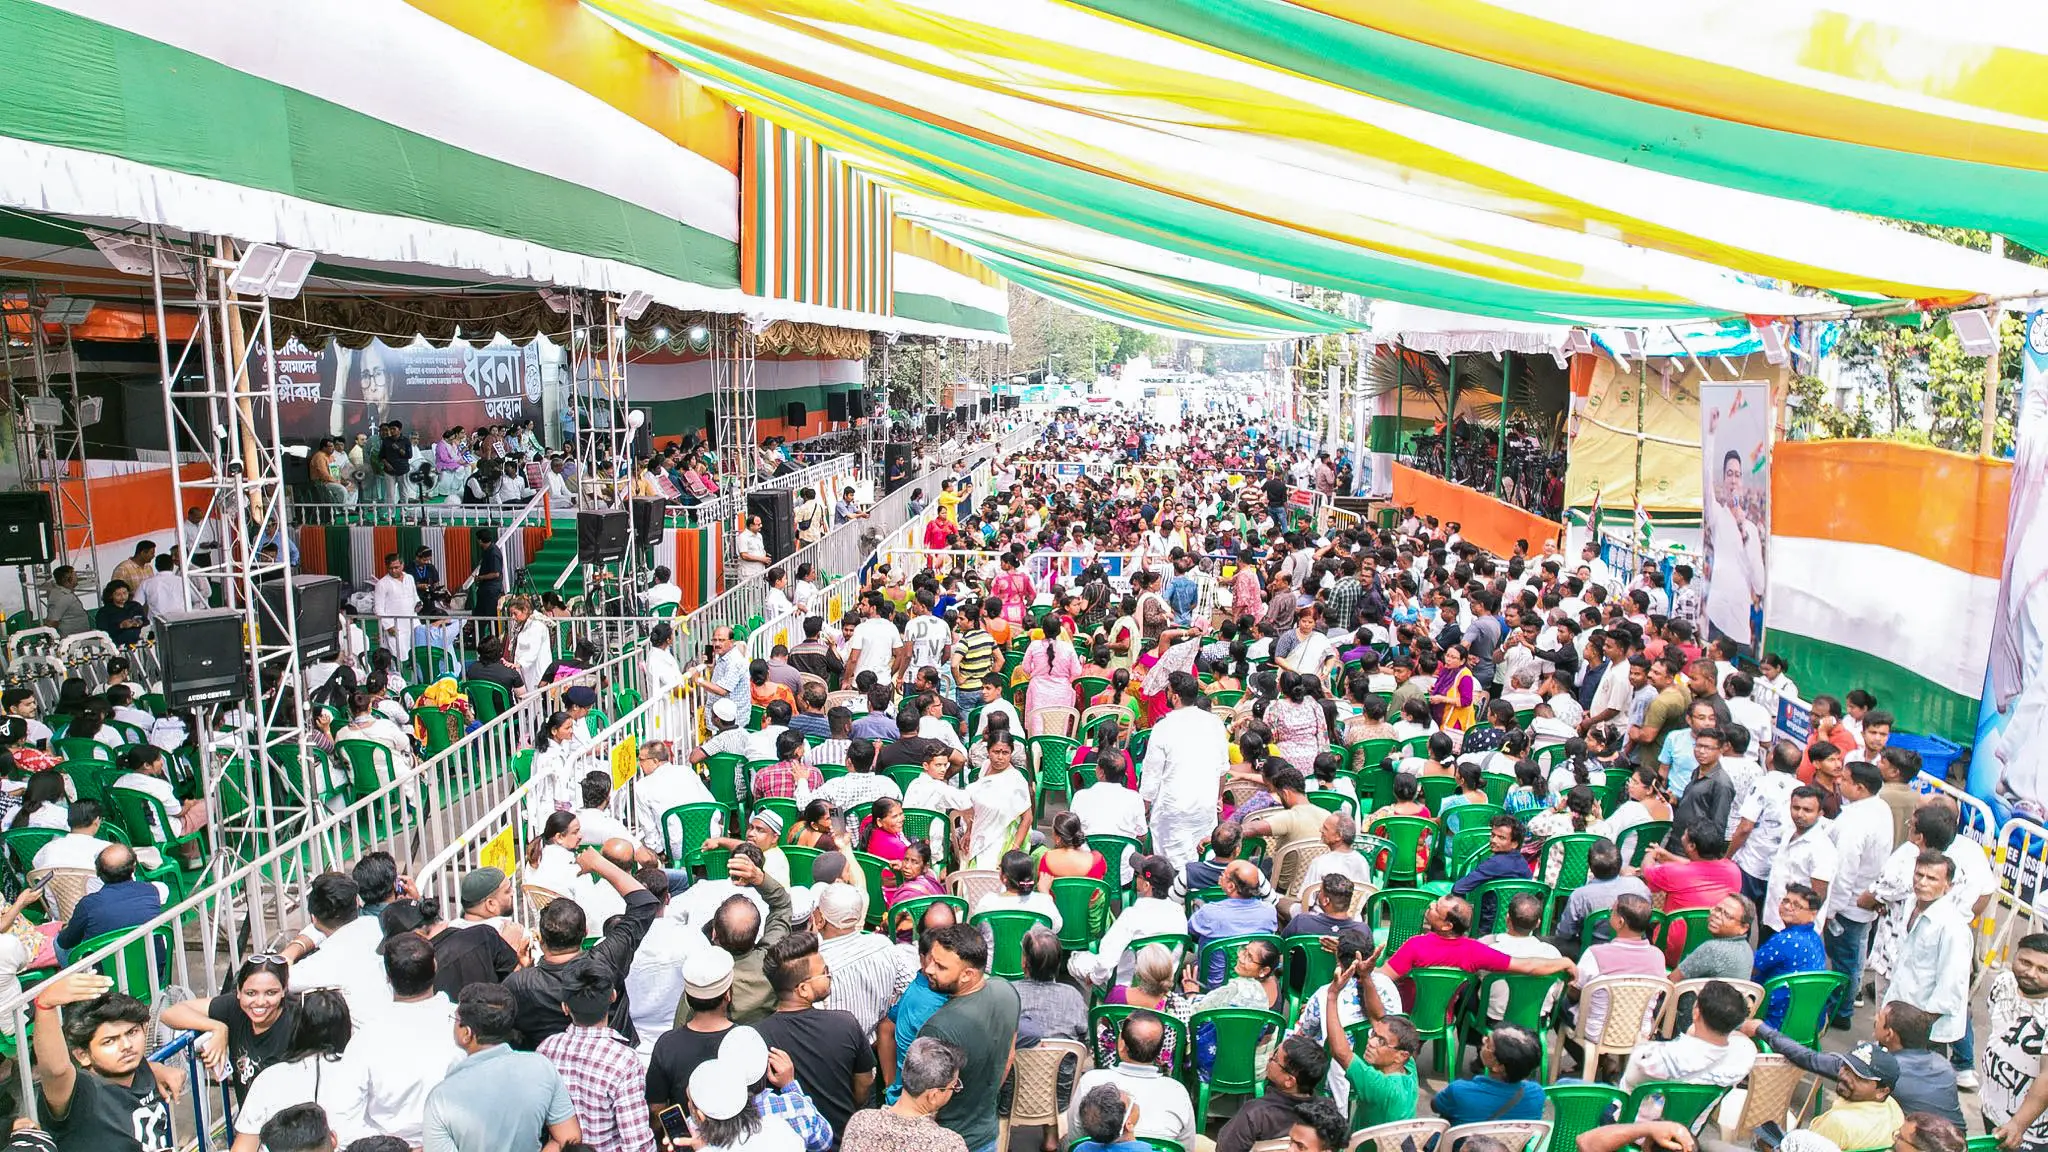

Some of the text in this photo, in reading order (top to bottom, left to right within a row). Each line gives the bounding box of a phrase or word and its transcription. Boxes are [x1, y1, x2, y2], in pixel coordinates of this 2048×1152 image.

[277, 360, 317, 375] আমাদের
[463, 345, 521, 397] ধরনা
[262, 374, 321, 403] ঙ্গীকার
[484, 398, 522, 421] অবস্থান
[187, 689, 231, 702] AUDIO CENTRE
